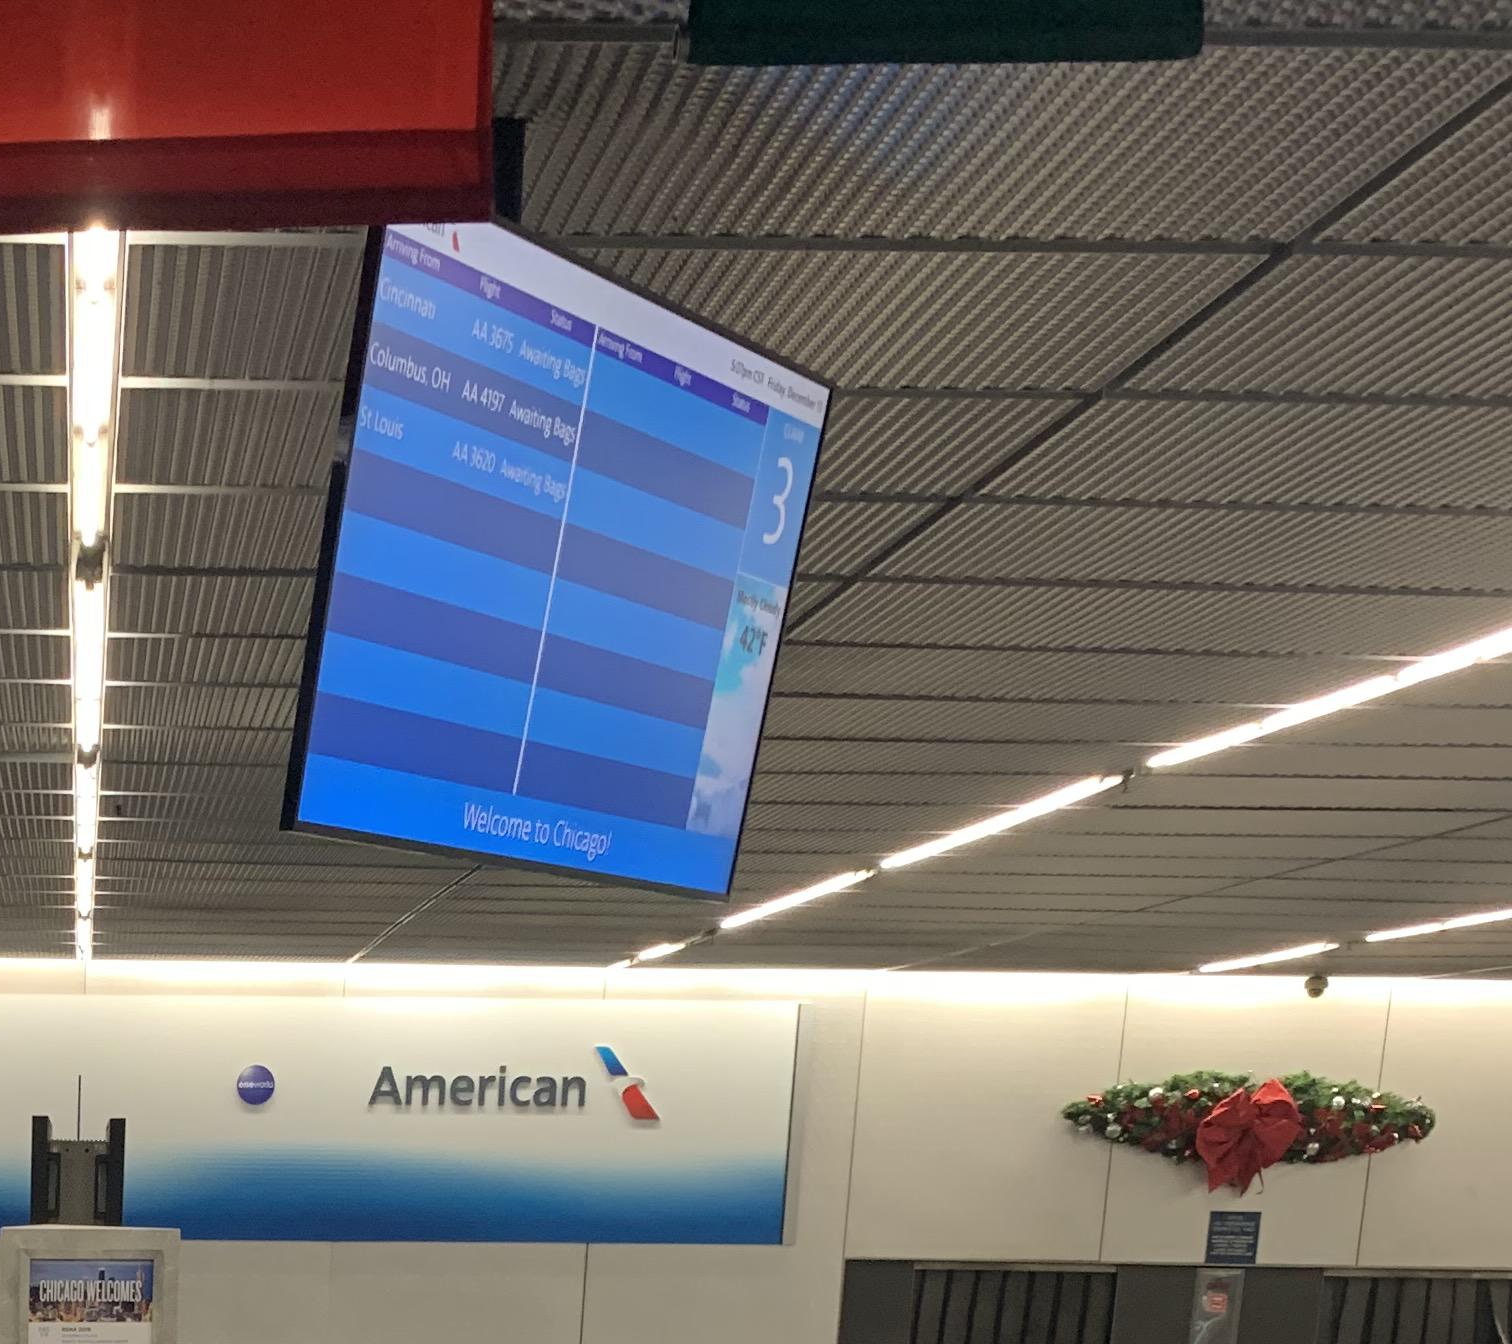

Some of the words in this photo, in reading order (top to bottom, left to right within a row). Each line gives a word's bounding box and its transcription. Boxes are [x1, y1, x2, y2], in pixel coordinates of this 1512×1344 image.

[386, 233, 418, 266] Arriving
[418, 247, 440, 273] From
[479, 275, 502, 299] Flight
[378, 277, 436, 321] Cincinnati
[471, 319, 488, 342] AA
[489, 326, 514, 354] 3675
[519, 339, 561, 380] Awaiting
[562, 358, 587, 389] Bags
[369, 341, 429, 387] Columbus,
[431, 366, 452, 393] OH
[461, 379, 478, 404] AA
[479, 384, 506, 413] 4197
[508, 399, 553, 439] Awaiting
[553, 416, 577, 446] Bags
[359, 405, 372, 429] St
[373, 411, 405, 441] Louis
[451, 440, 468, 463] AA
[469, 445, 496, 474] 3620
[499, 458, 541, 496] Awaiting
[543, 473, 567, 503] Bags
[762, 456, 794, 546] 3
[738, 623, 769, 657] 42°F
[463, 801, 532, 841] Welcome
[533, 817, 550, 844] to
[553, 819, 614, 863] Chicago!
[367, 1065, 587, 1108] American
[39, 1279, 85, 1302] CHICAGO
[86, 1279, 143, 1302] WELCOMES
